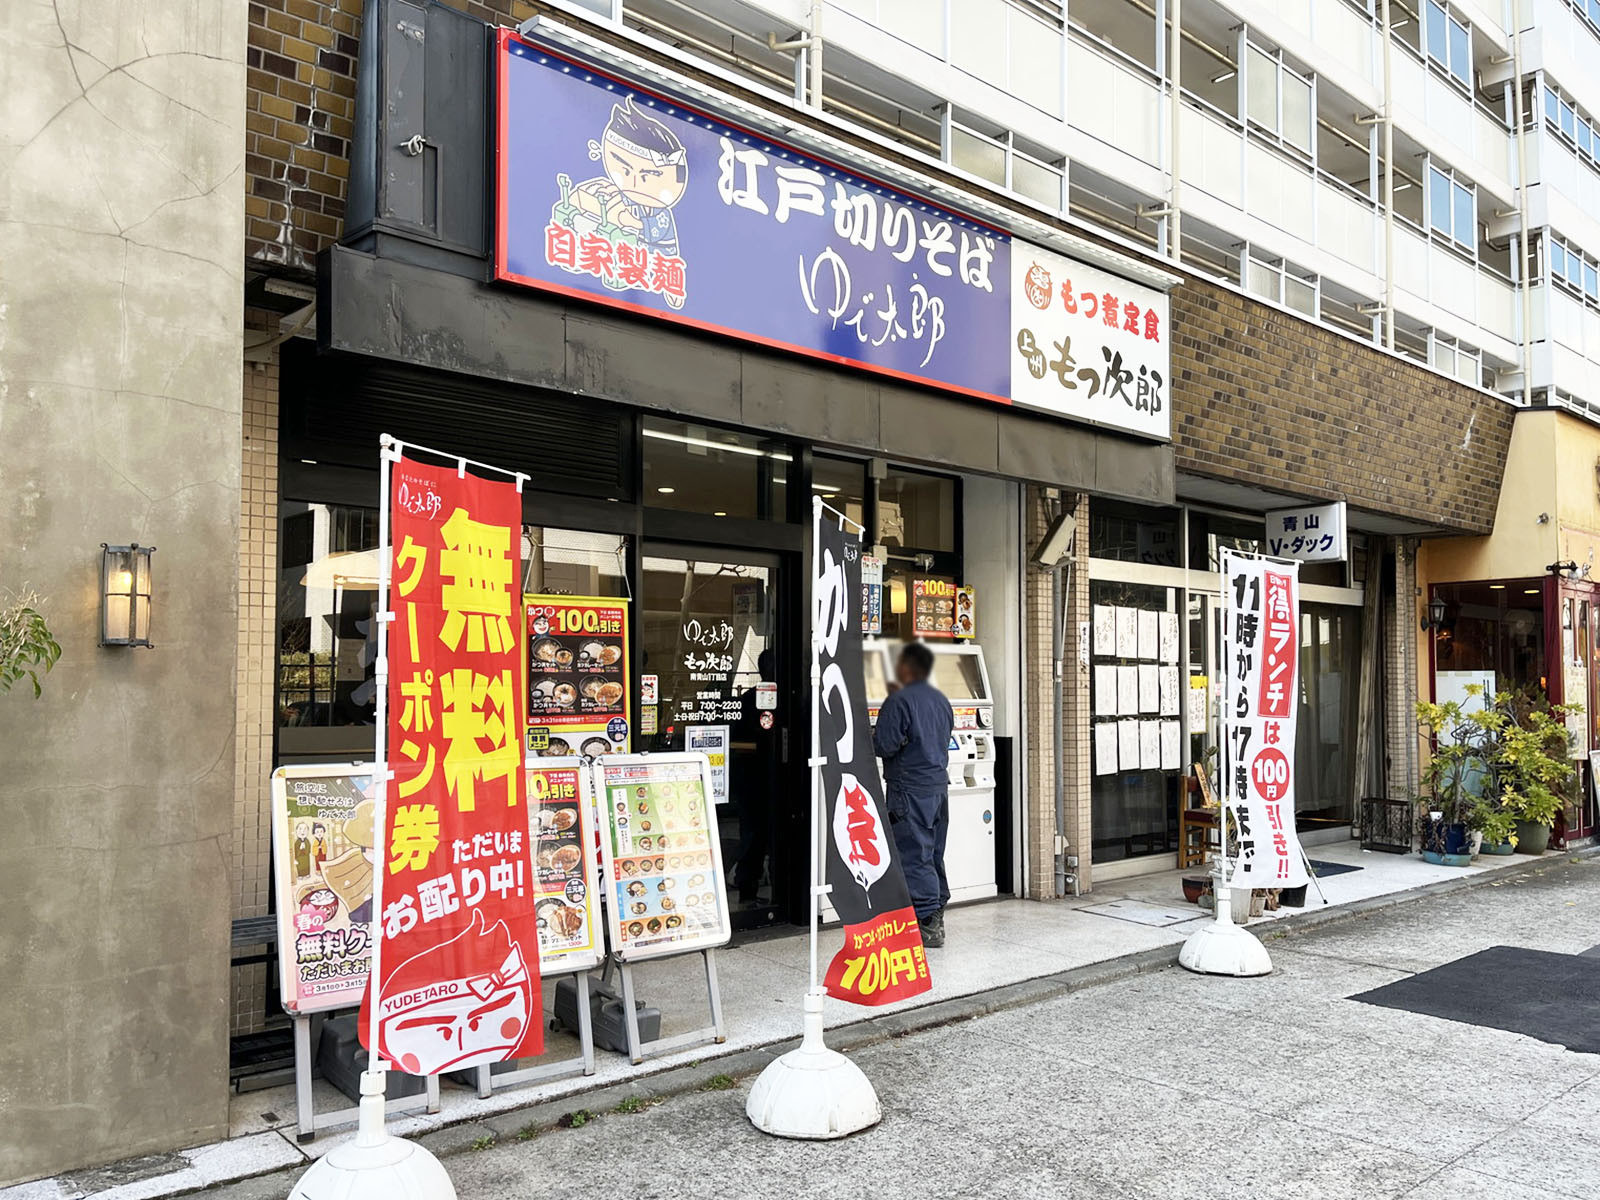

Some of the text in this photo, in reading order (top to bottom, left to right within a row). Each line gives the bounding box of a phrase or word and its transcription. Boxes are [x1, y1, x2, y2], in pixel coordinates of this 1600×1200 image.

[717, 136, 996, 293] 江戸切りそば
[546, 221, 685, 297] 自家製麺
[799, 246, 946, 368] ゆで太郎
[1060, 278, 1160, 343] もつ煮定食
[1020, 331, 1044, 377] 上州
[1049, 335, 1163, 417] もつ次郎
[398, 482, 442, 520] ゆで太郎
[1282, 514, 1320, 532] 青山
[438, 507, 521, 812] 無料
[683, 619, 734, 650] ゆで太郎
[684, 652, 733, 671] もつ次郎
[388, 535, 440, 875] クーポン券
[452, 830, 523, 864] ただいま
[296, 914, 323, 930] 春の
[383, 859, 524, 940] お配り中!
[384, 983, 459, 1013] YUDETARO
